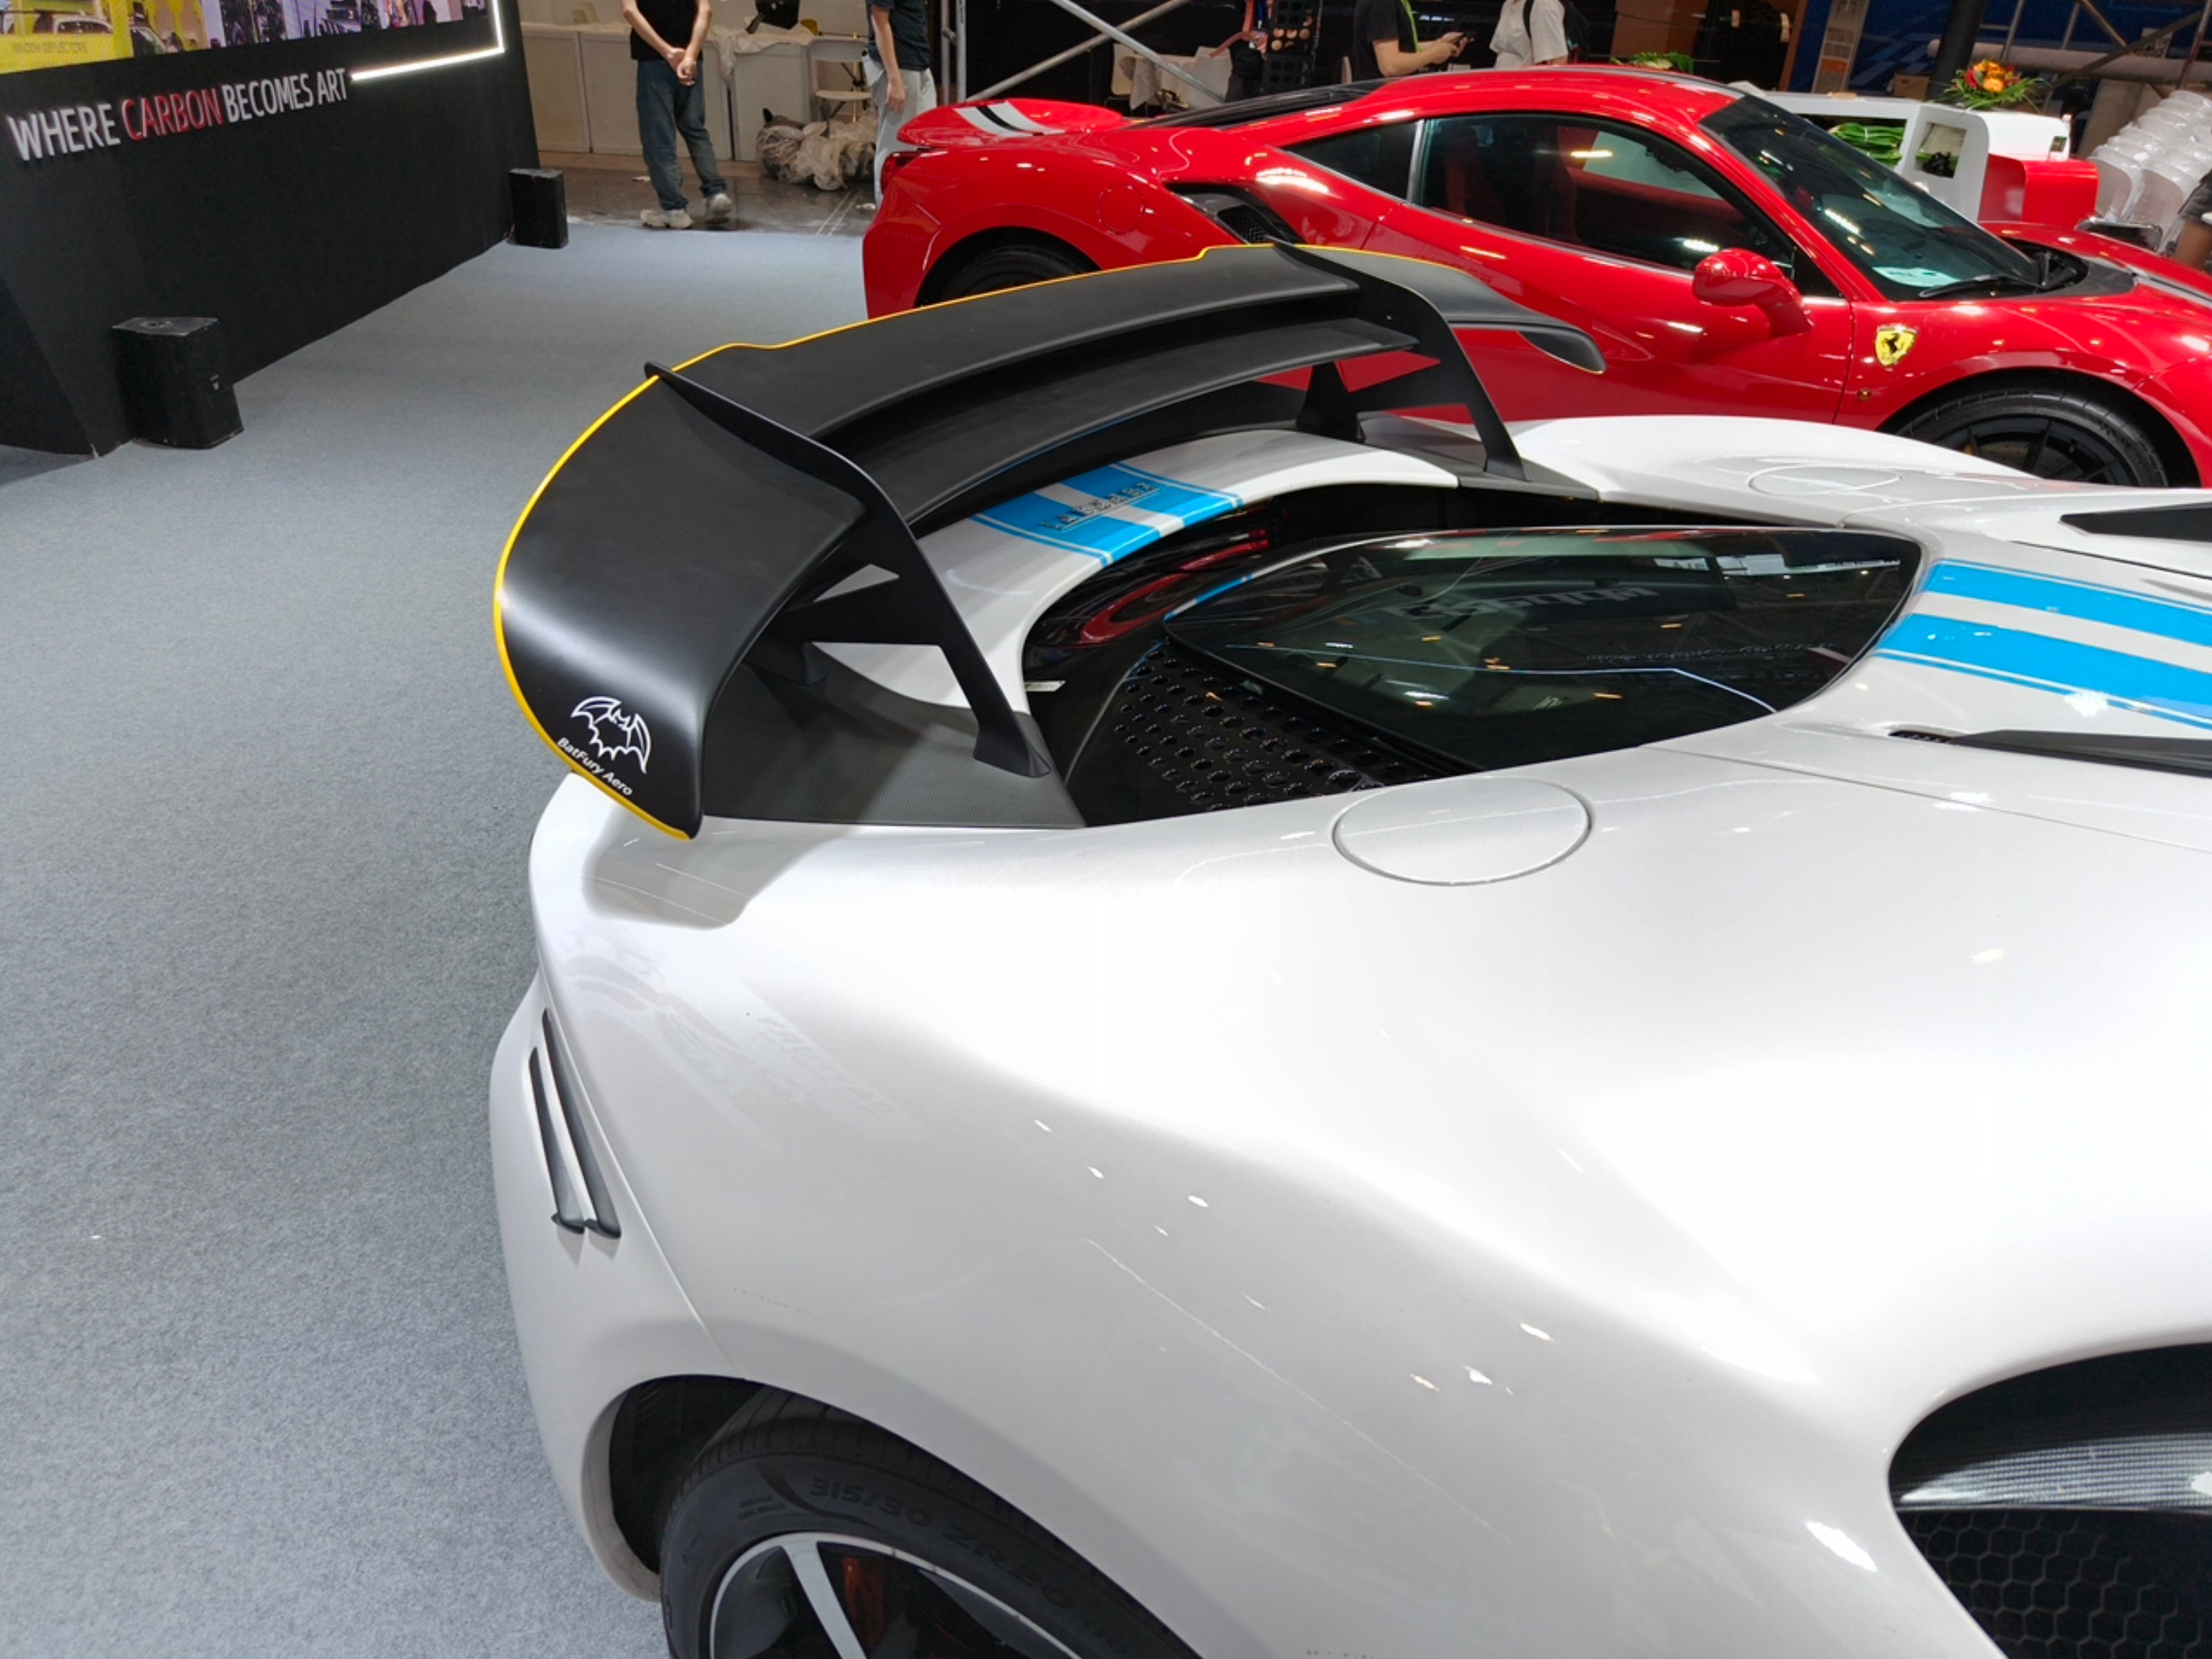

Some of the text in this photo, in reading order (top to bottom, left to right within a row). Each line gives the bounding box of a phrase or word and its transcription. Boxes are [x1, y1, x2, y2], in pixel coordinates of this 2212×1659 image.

[6, 68, 347, 161] WHERE CARBON BECOMES ART
[556, 736, 633, 796] BatFury Aero
[809, 1477, 931, 1528] 315/30
